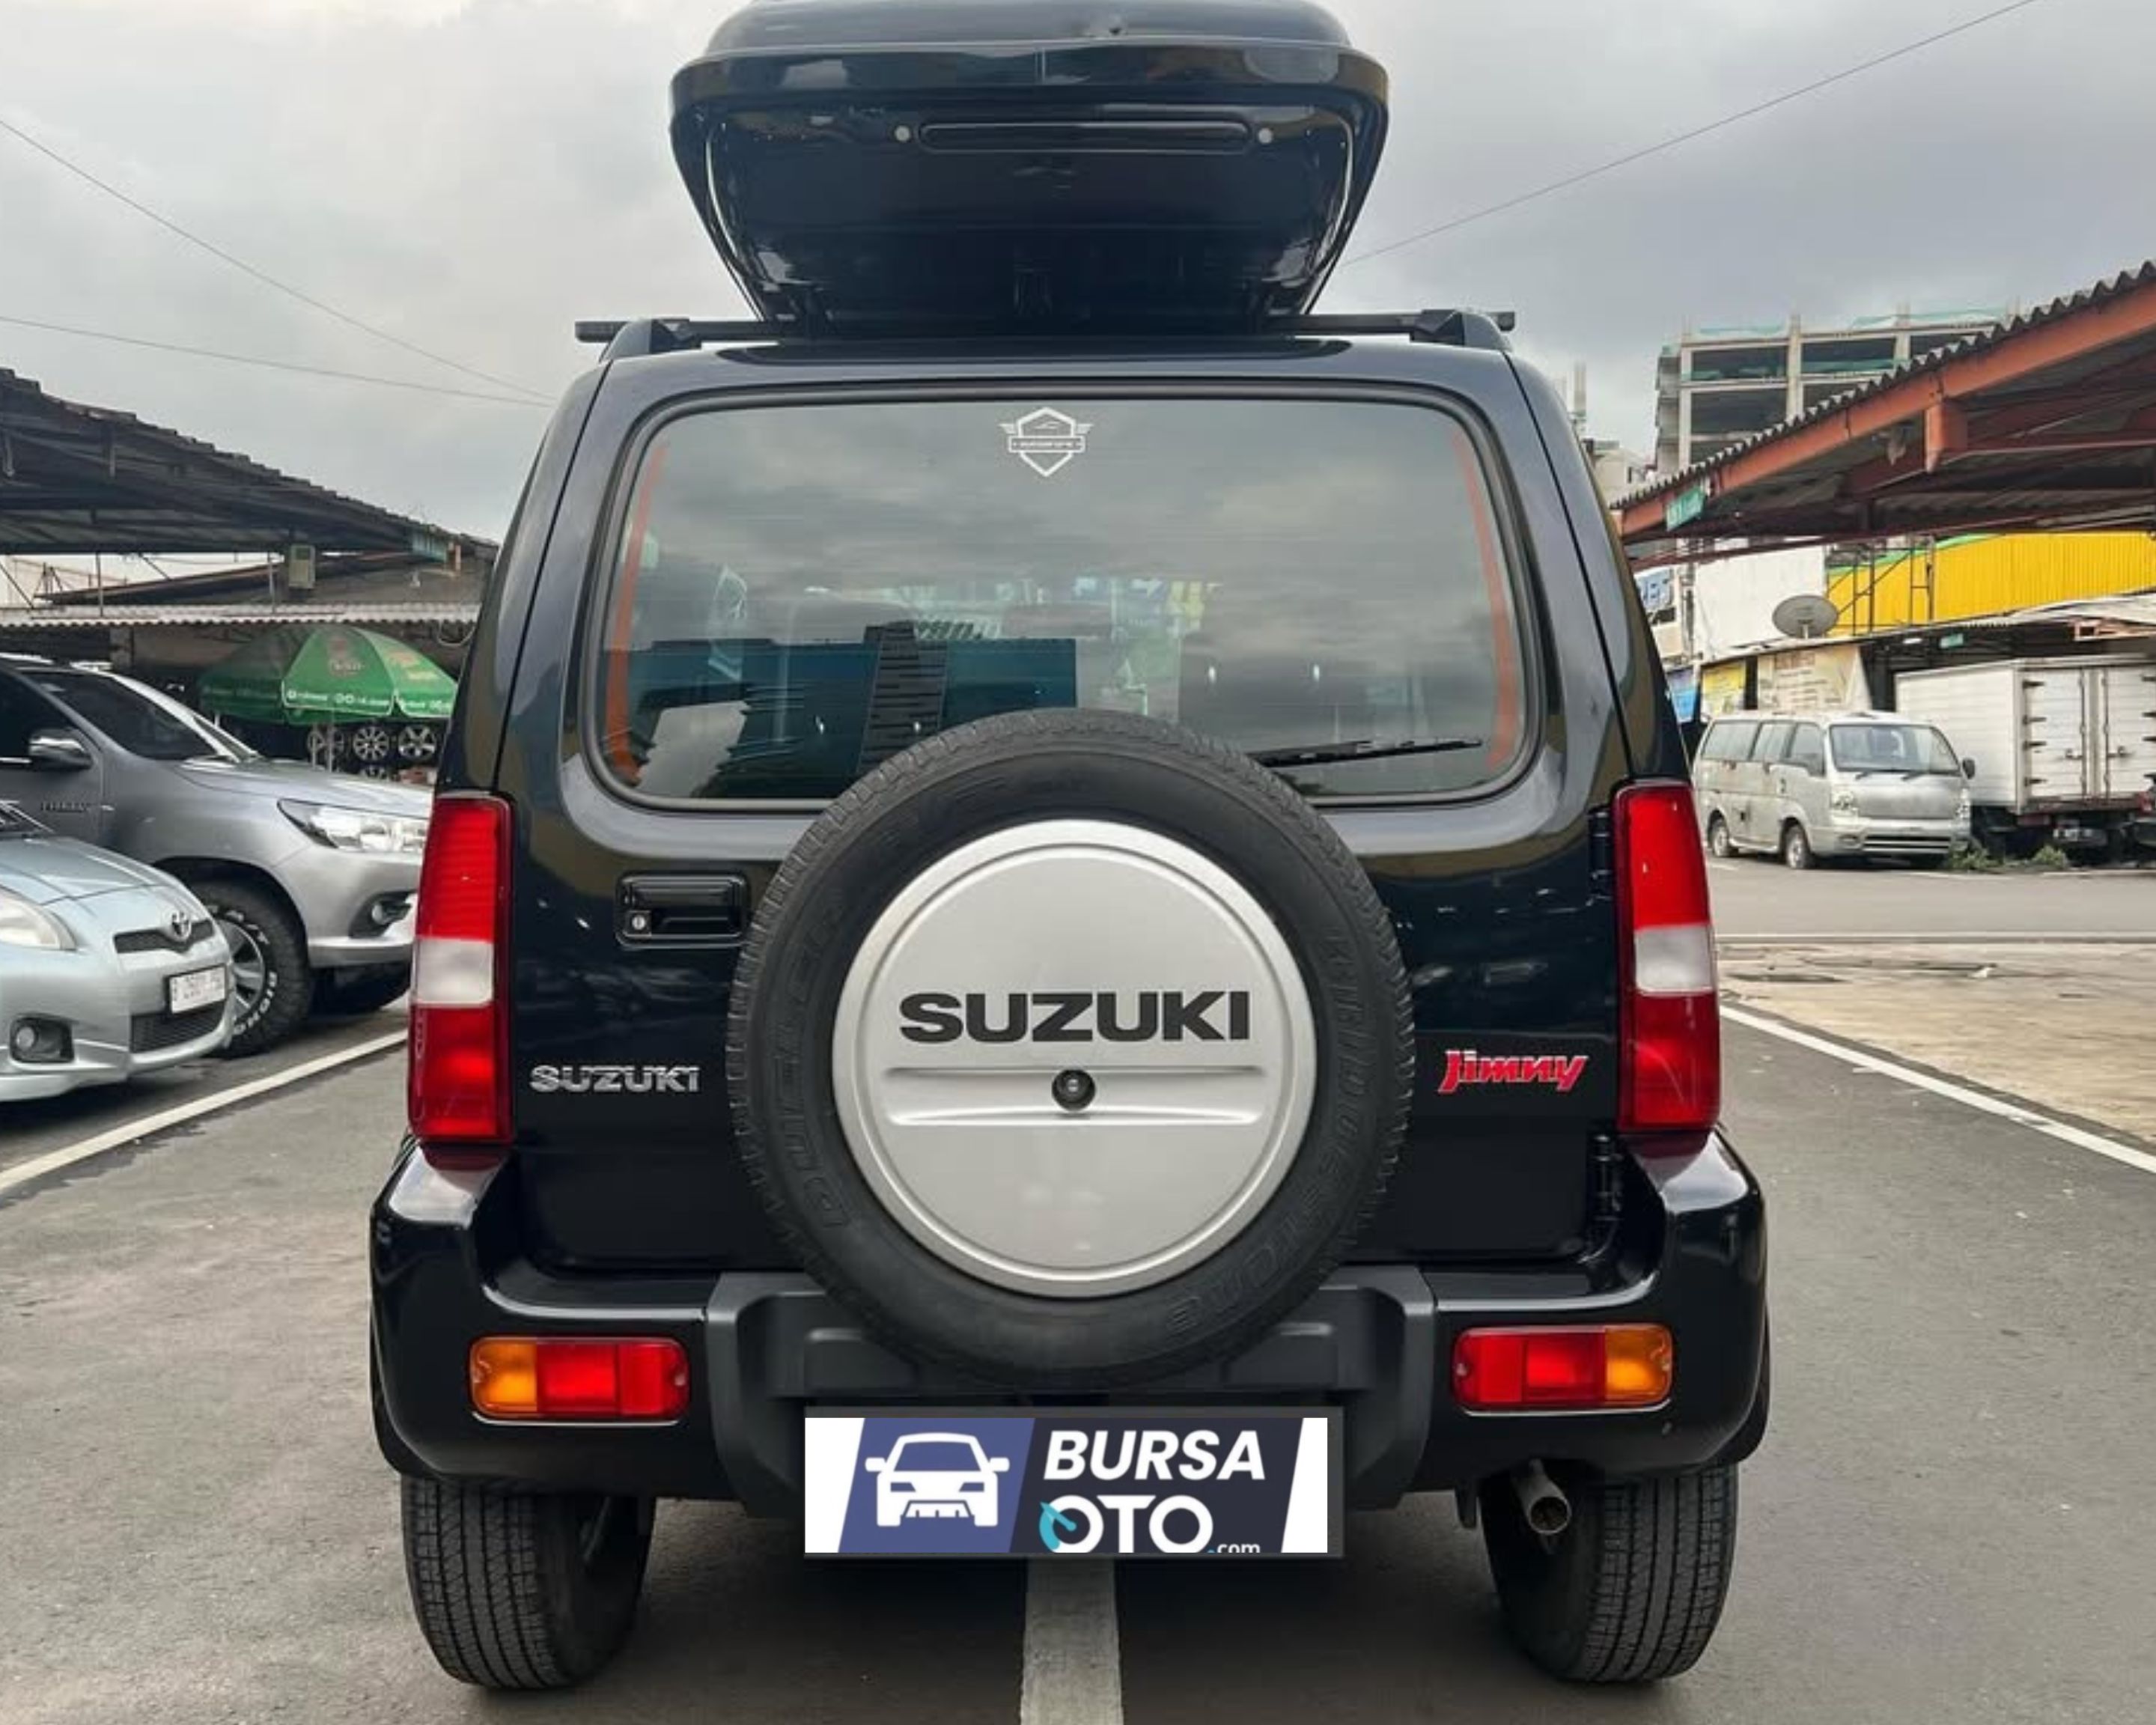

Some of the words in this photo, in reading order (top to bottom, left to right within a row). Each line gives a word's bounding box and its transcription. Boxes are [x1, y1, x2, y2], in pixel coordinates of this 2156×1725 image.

[898, 991, 1250, 1043] SUZUKI
[529, 1064, 701, 1092] SUZUKI
[1437, 1049, 1589, 1094] Jimny
